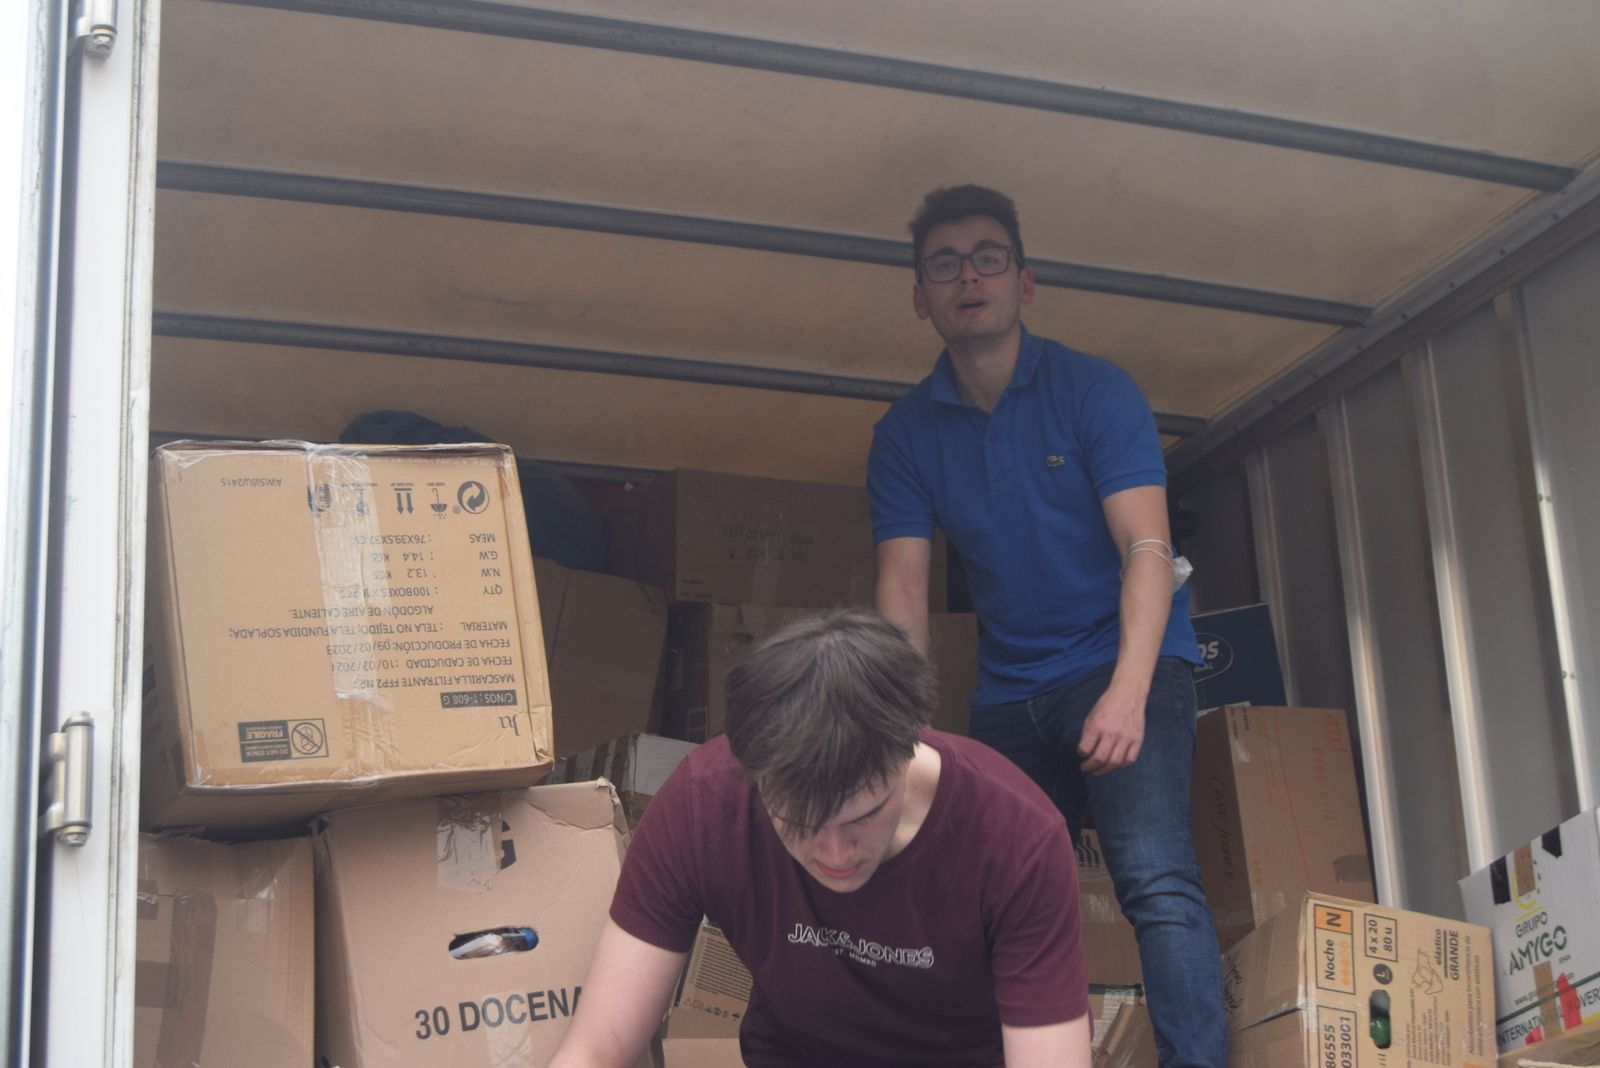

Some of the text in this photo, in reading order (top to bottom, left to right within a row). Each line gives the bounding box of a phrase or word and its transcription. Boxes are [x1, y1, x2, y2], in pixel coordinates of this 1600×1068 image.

[469, 533, 496, 543] MEAS
[403, 552, 424, 562] 14.4
[479, 550, 498, 560] G.W
[407, 568, 428, 578] 13.2
[481, 568, 500, 578] N.W
[483, 584, 503, 595] QTY
[288, 606, 434, 619] ALGODÓN DE AIRE CALIENTE.
[330, 626, 358, 636] TELA
[396, 624, 412, 634] NO
[415, 623, 438, 633] TELA
[460, 620, 508, 632] MATERIAL
[228, 628, 281, 639] SOPLADA;
[281, 627, 328, 638] FUNDIDA
[464, 640, 477, 649] DE
[479, 638, 510, 648] FECHA
[406, 658, 464, 668] CADUCIDAD
[467, 657, 480, 667] DE
[481, 656, 512, 666] FECHA
[376, 679, 399, 688] FFP2
[402, 676, 452, 687] FILTRANTE
[454, 674, 514, 685] MASCARILLA
[246, 730, 283, 740] FRAGILE
[1326, 912, 1341, 928] N
[1516, 912, 1548, 938] GRUPO
[1368, 920, 1378, 934] 20
[1383, 937, 1392, 952] 80
[1465, 936, 1470, 945] de
[1434, 928, 1442, 966] elástico
[1509, 925, 1567, 976] AMYGO
[1323, 939, 1336, 980] Noche
[1449, 930, 1460, 981] GRANDE
[414, 1006, 450, 1040] 30
